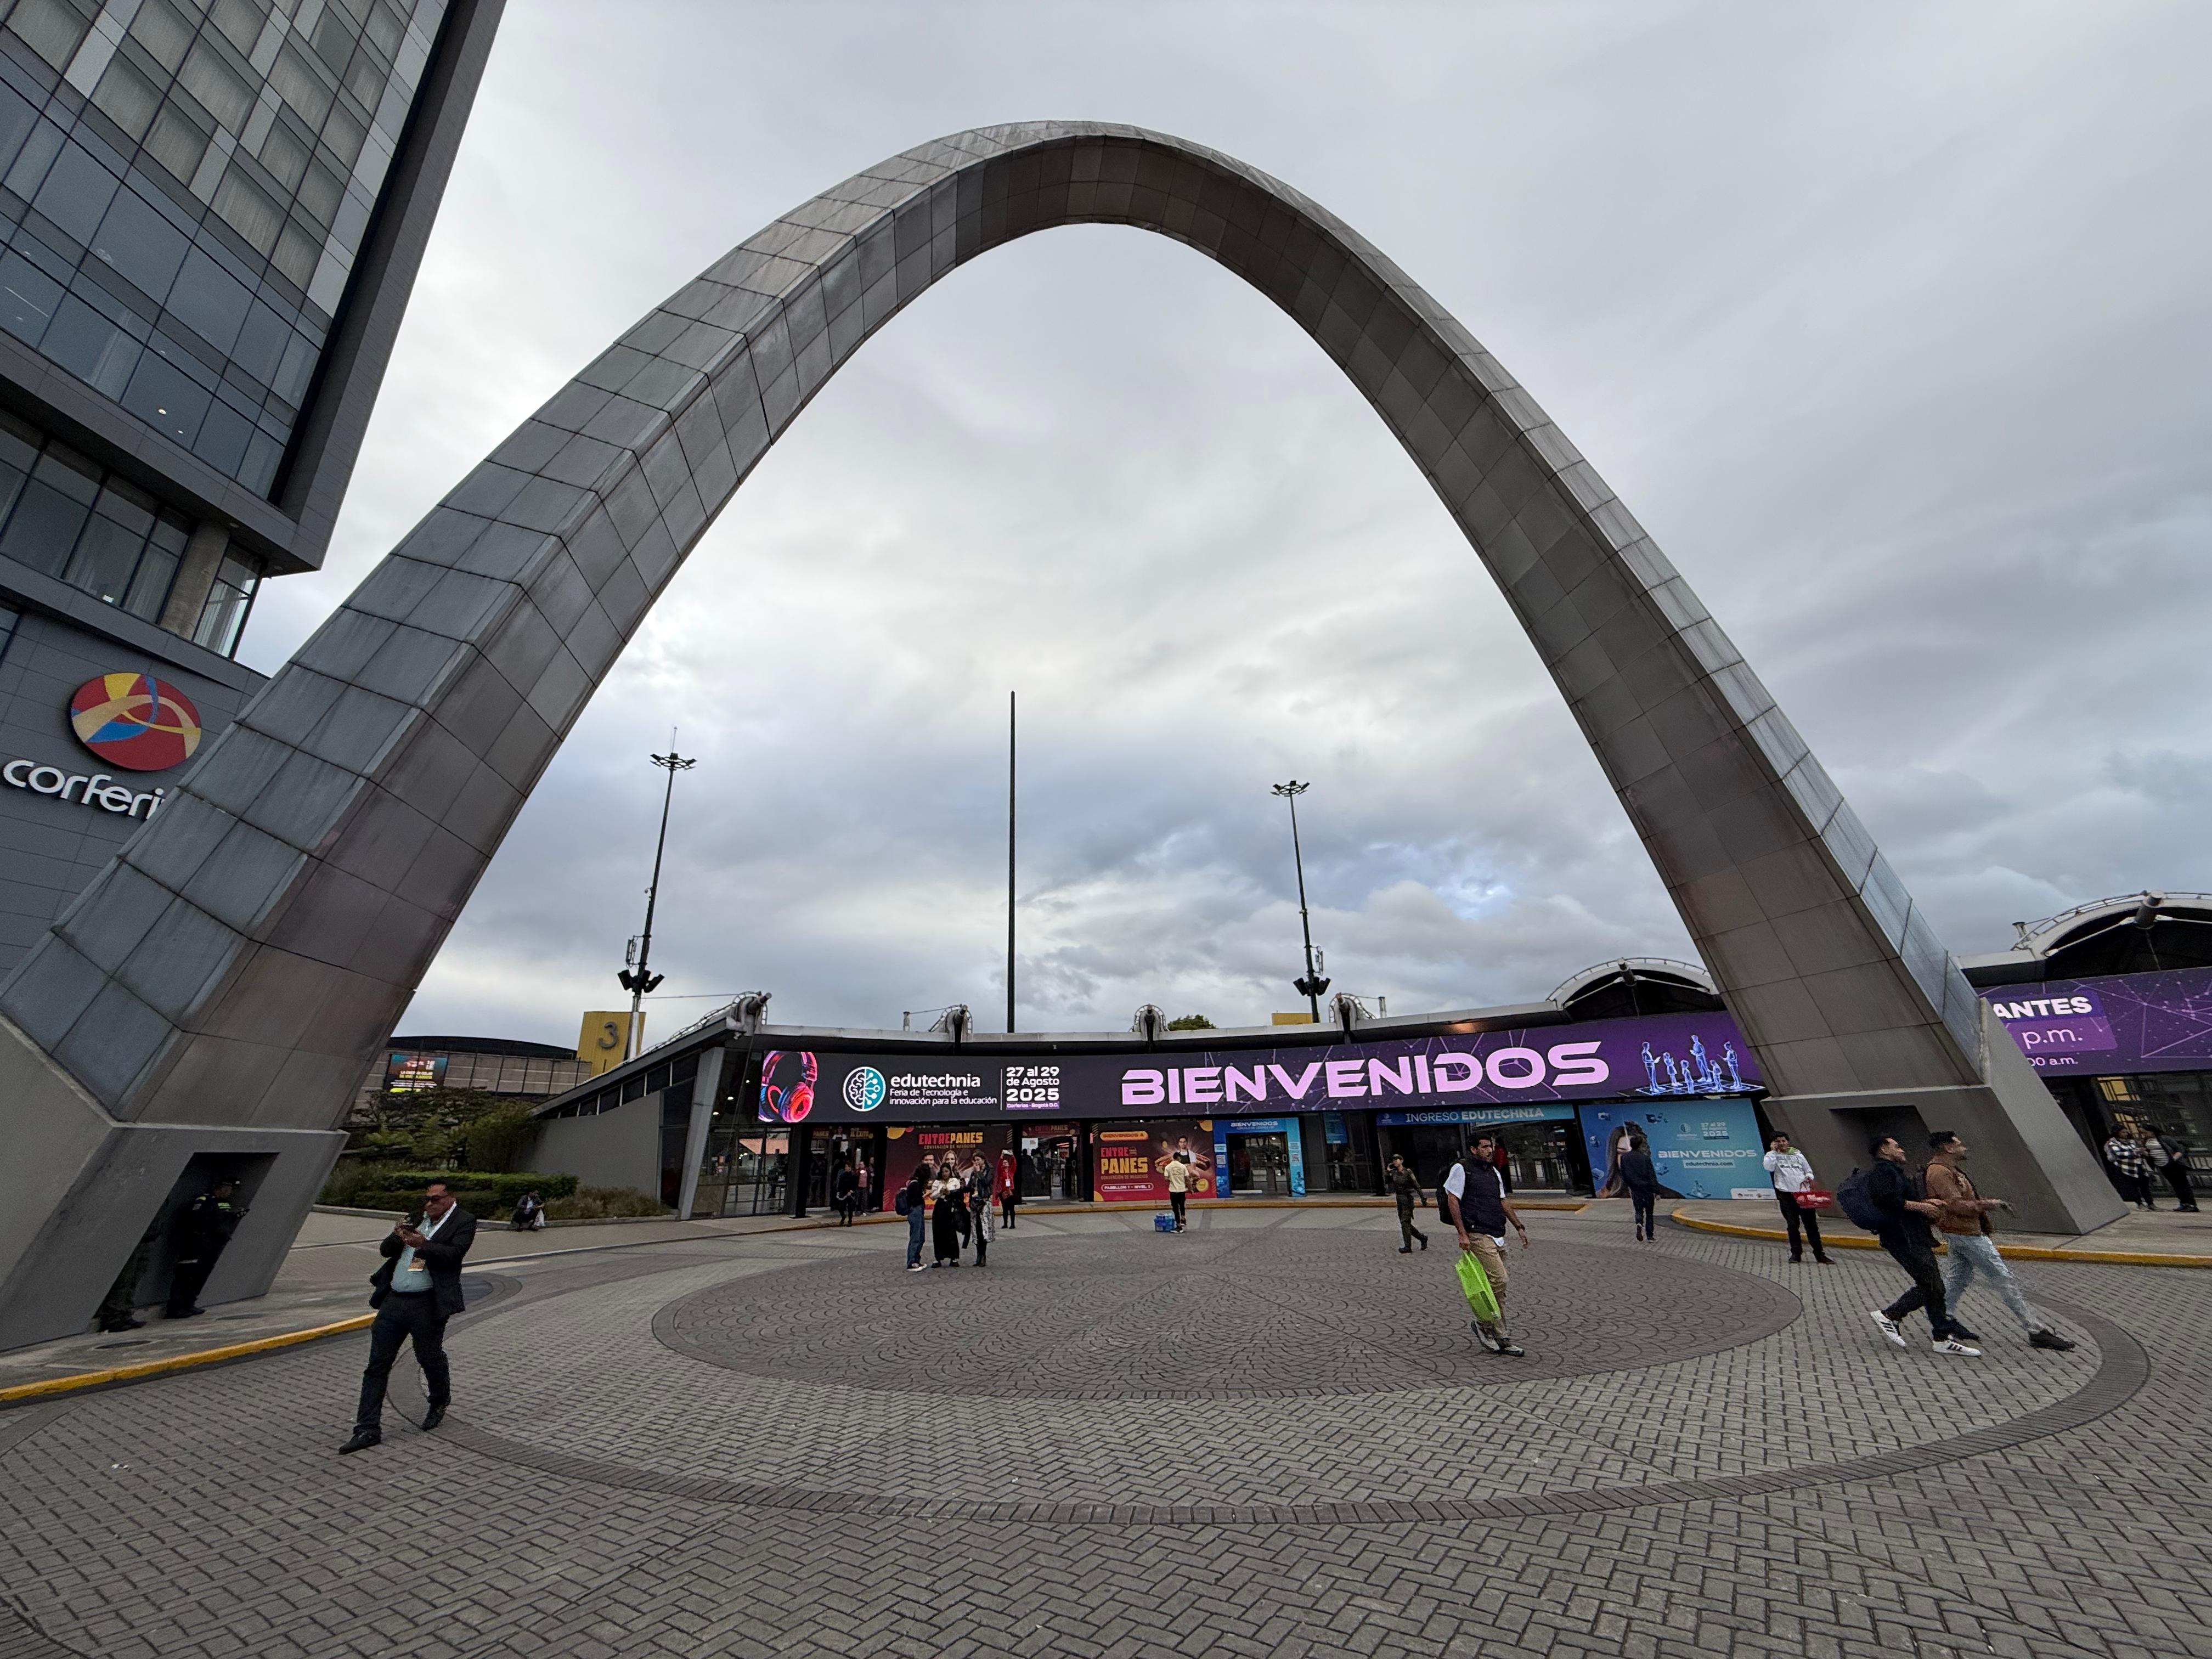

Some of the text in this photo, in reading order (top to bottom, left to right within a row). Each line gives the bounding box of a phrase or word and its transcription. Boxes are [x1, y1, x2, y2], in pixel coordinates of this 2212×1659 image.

[3, 760, 165, 820] corferi
[1993, 996, 2093, 1019] ANTES
[597, 1022, 618, 1049] 3
[2022, 1028, 2083, 1050] p.m.
[2049, 1057, 2079, 1065] a.m.
[1006, 1066, 1059, 1077] 27 al 29
[1121, 1041, 1610, 1105] BIENVENIDOS
[890, 1074, 981, 1087] edutechnia
[1006, 1077, 1060, 1088] de Agosto
[922, 1088, 961, 1098] Tecnología
[1006, 1088, 1060, 1102] 2025
[889, 1097, 997, 1107] innovación para la educación
[1405, 1107, 1545, 1123] INGRESO EDUTECHNIA
[918, 1132, 983, 1144] ENTREPANES
[1101, 1147, 1129, 1158] ENTRE
[1658, 1149, 1757, 1159] BIENVENIDOS
[1101, 1157, 1148, 1175] PANES
